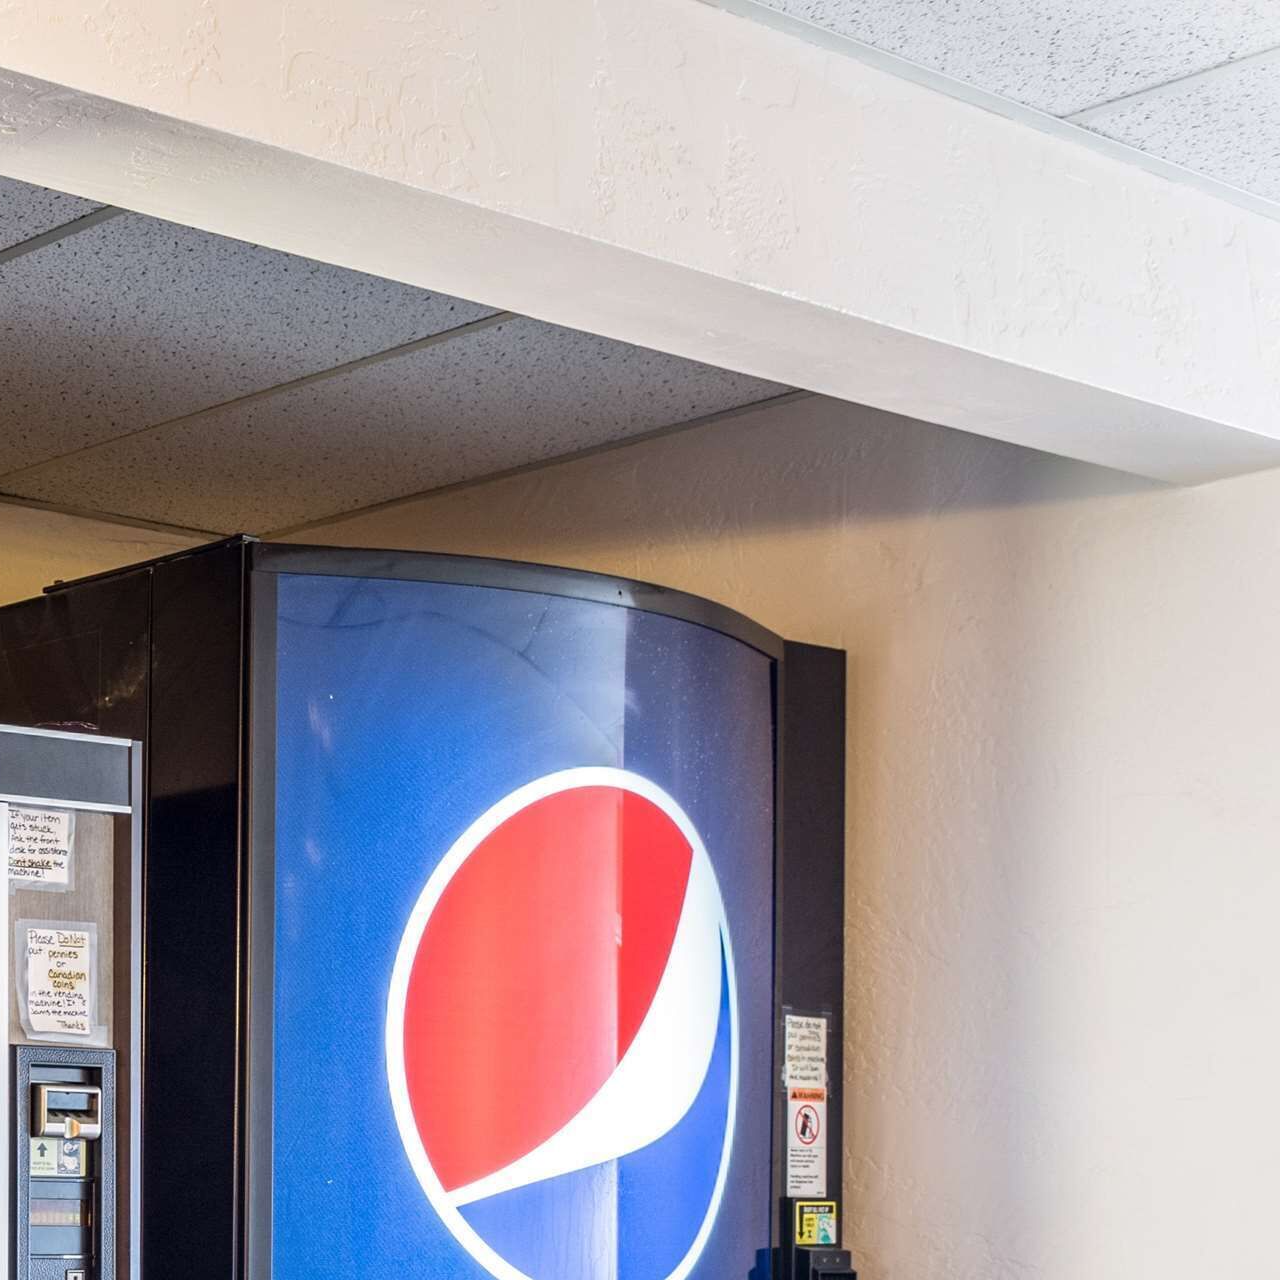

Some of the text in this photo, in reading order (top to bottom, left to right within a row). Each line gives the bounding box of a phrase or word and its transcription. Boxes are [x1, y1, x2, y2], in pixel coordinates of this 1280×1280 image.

[21, 814, 39, 823] your
[40, 813, 61, 824] item
[40, 834, 60, 844] front
[28, 929, 55, 945] Please
[48, 950, 79, 960] pennies
[48, 969, 86, 981] Canadian
